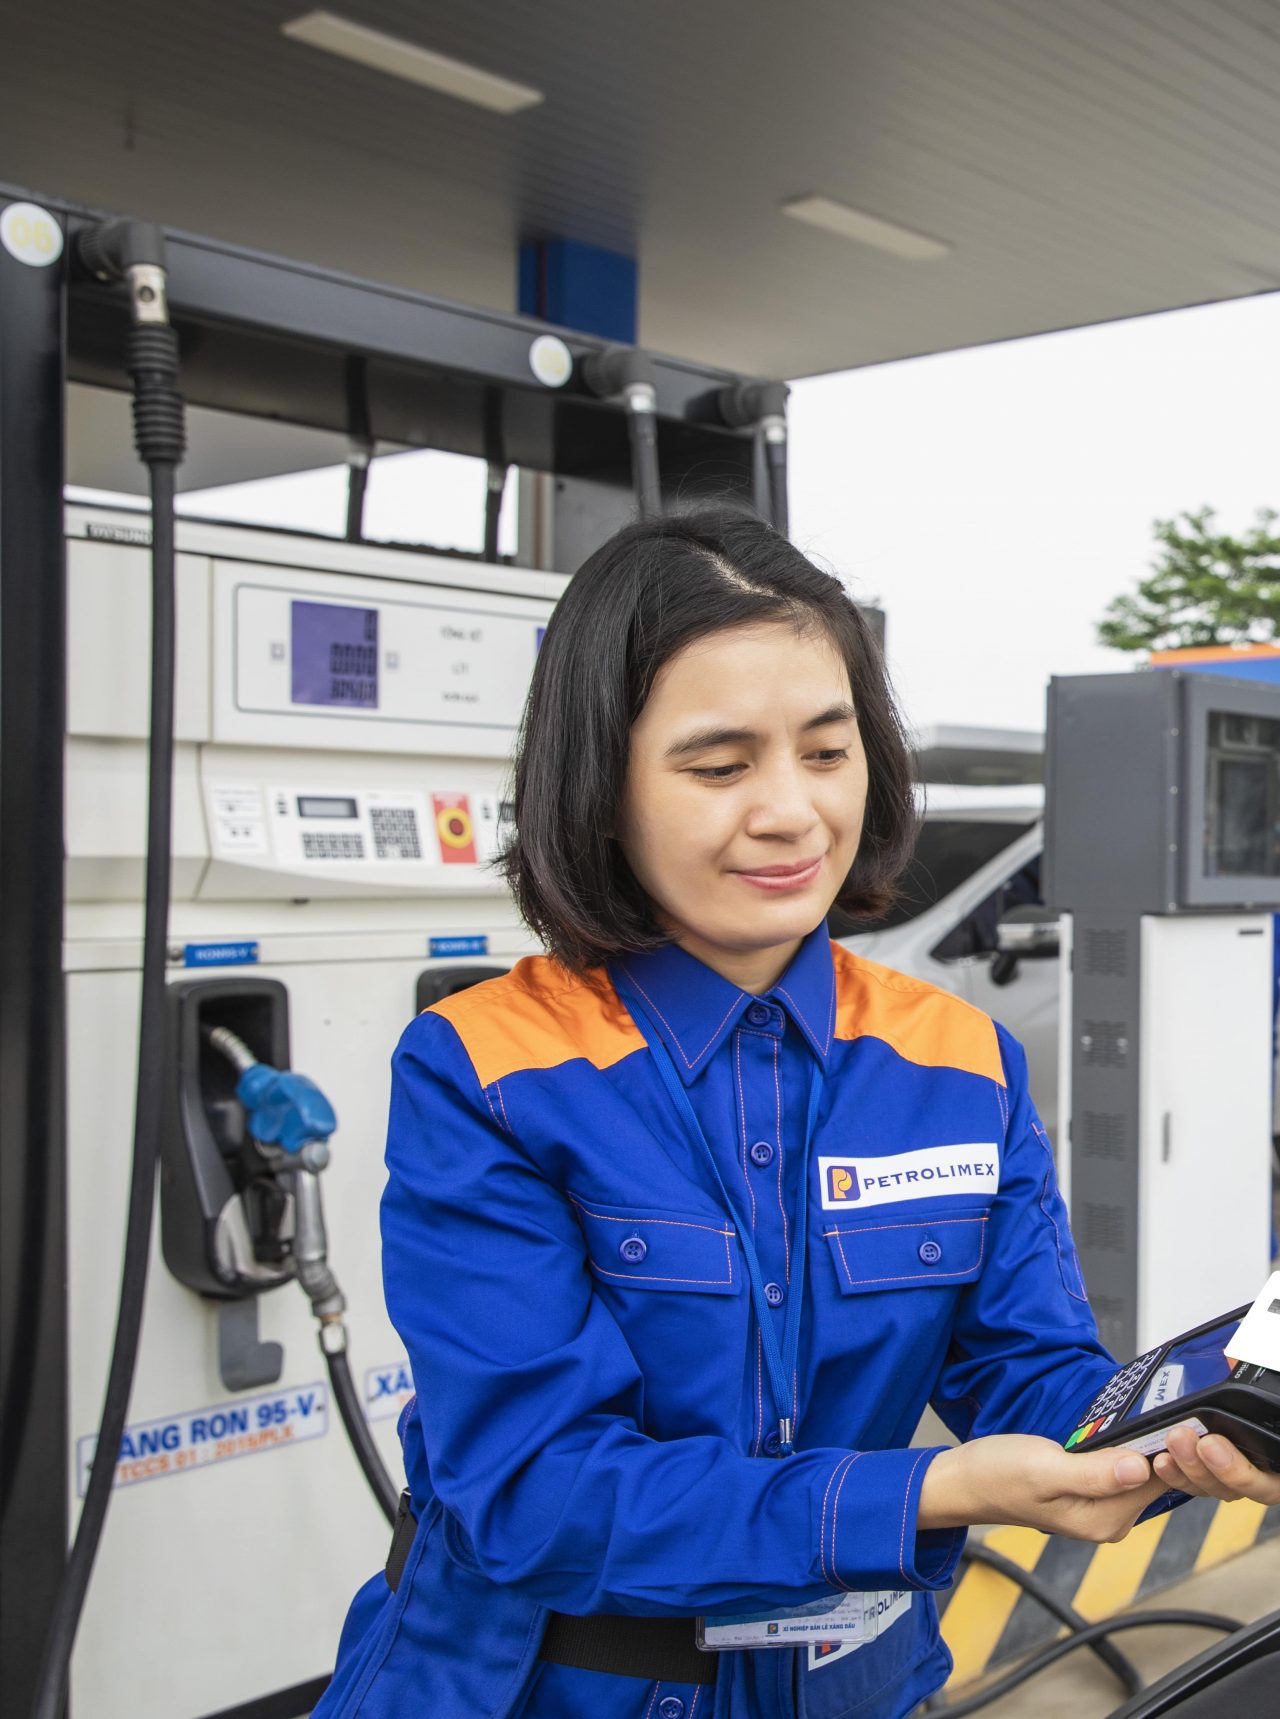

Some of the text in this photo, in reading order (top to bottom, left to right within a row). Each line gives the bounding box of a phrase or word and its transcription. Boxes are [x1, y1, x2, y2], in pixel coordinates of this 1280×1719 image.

[863, 1163, 995, 1190] PETROLIMEX
[190, 1408, 249, 1444] RON
[256, 1392, 315, 1428] 95-V
[119, 1456, 170, 1481] TCCS
